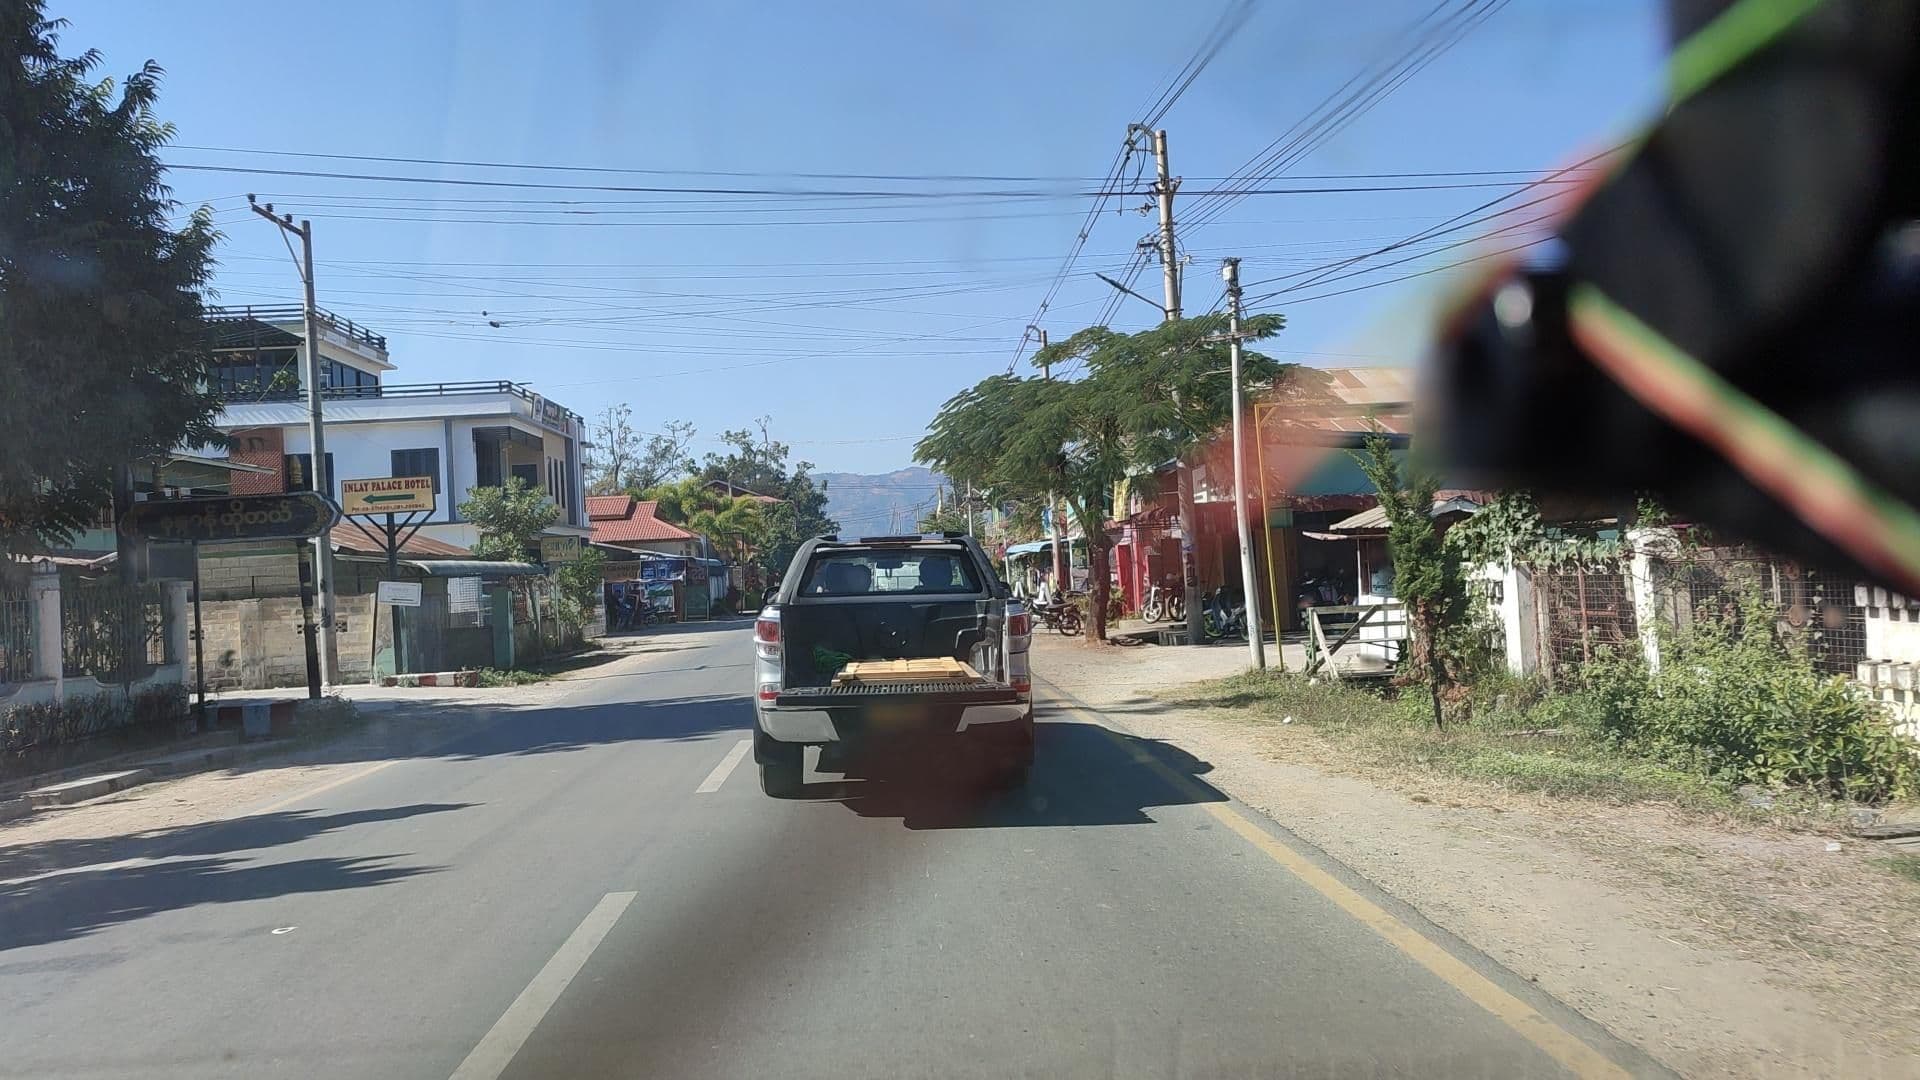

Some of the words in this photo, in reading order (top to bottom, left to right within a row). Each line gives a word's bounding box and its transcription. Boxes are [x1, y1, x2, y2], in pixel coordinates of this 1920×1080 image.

[344, 482, 369, 493] INLAY
[371, 480, 404, 491] PALACE
[404, 479, 431, 489] HOTEL
